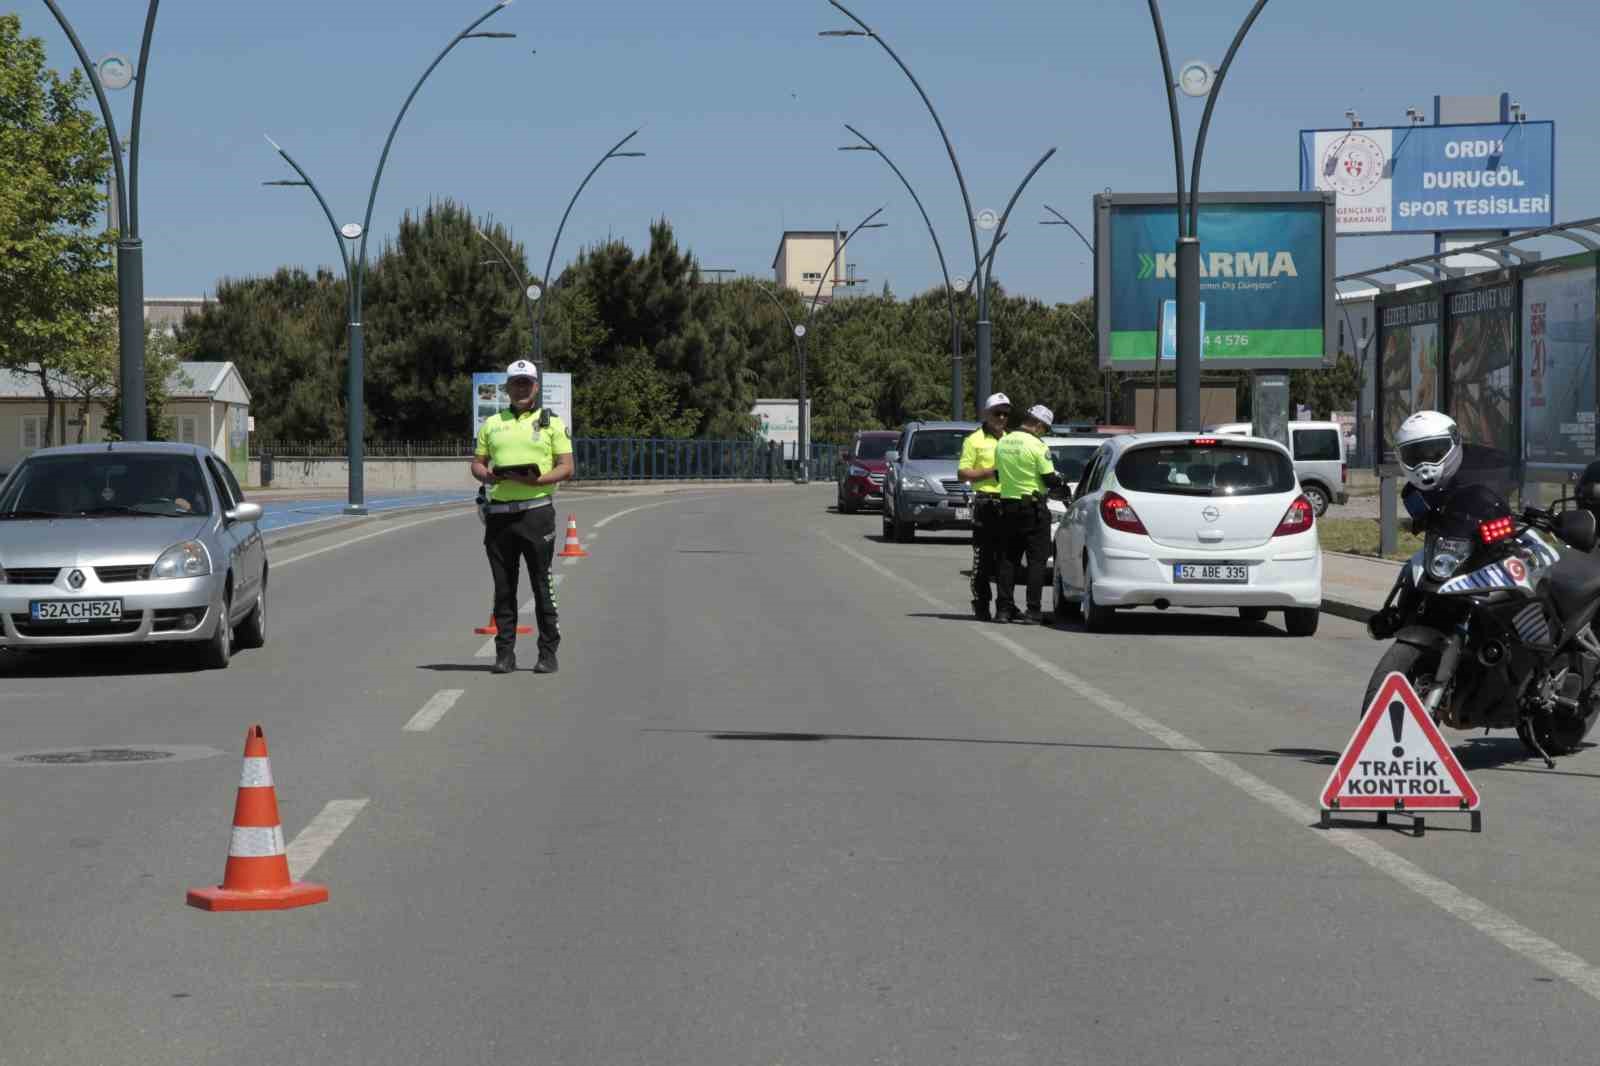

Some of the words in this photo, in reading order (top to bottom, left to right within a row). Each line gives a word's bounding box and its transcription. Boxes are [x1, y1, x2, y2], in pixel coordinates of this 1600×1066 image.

[1445, 140, 1504, 159] ORDU
[1423, 166, 1525, 189] DURUGÖL
[1399, 200, 1449, 217] SPOR
[1454, 194, 1551, 215] TESİSLERİ
[1183, 566, 1195, 577] 52
[1202, 566, 1221, 577] ABE
[1226, 566, 1245, 577] 335
[39, 602, 120, 618] 52ACH524
[1359, 757, 1438, 776] TRAFİK
[1348, 779, 1451, 794] KONTROL
